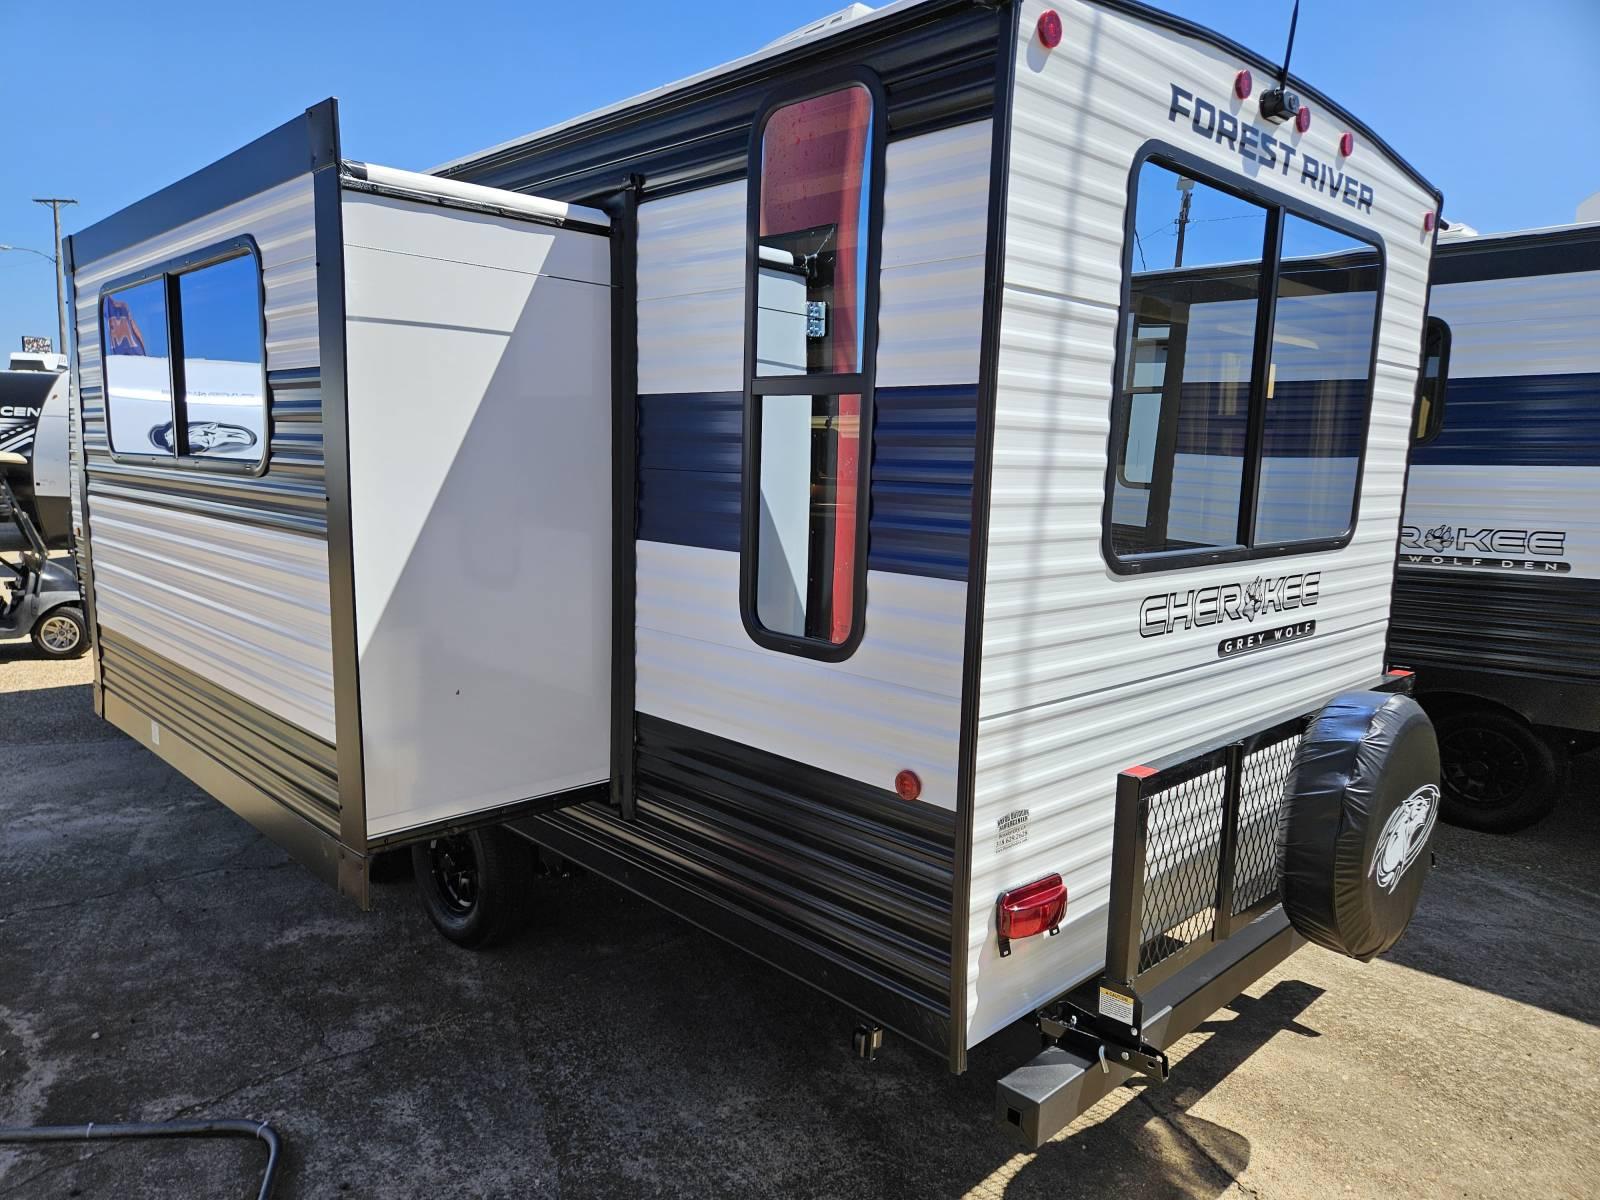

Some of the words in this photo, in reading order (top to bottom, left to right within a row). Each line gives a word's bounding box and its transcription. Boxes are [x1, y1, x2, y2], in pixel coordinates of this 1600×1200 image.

[1168, 83, 1296, 176] FOREST
[1301, 153, 1374, 215] RIVER
[1408, 555, 1483, 566] WOLF
[1501, 560, 1558, 571] DEN
[1139, 571, 1321, 638] CHEROKEE
[1224, 633, 1265, 653] GREY
[1274, 622, 1312, 641] WOLF
